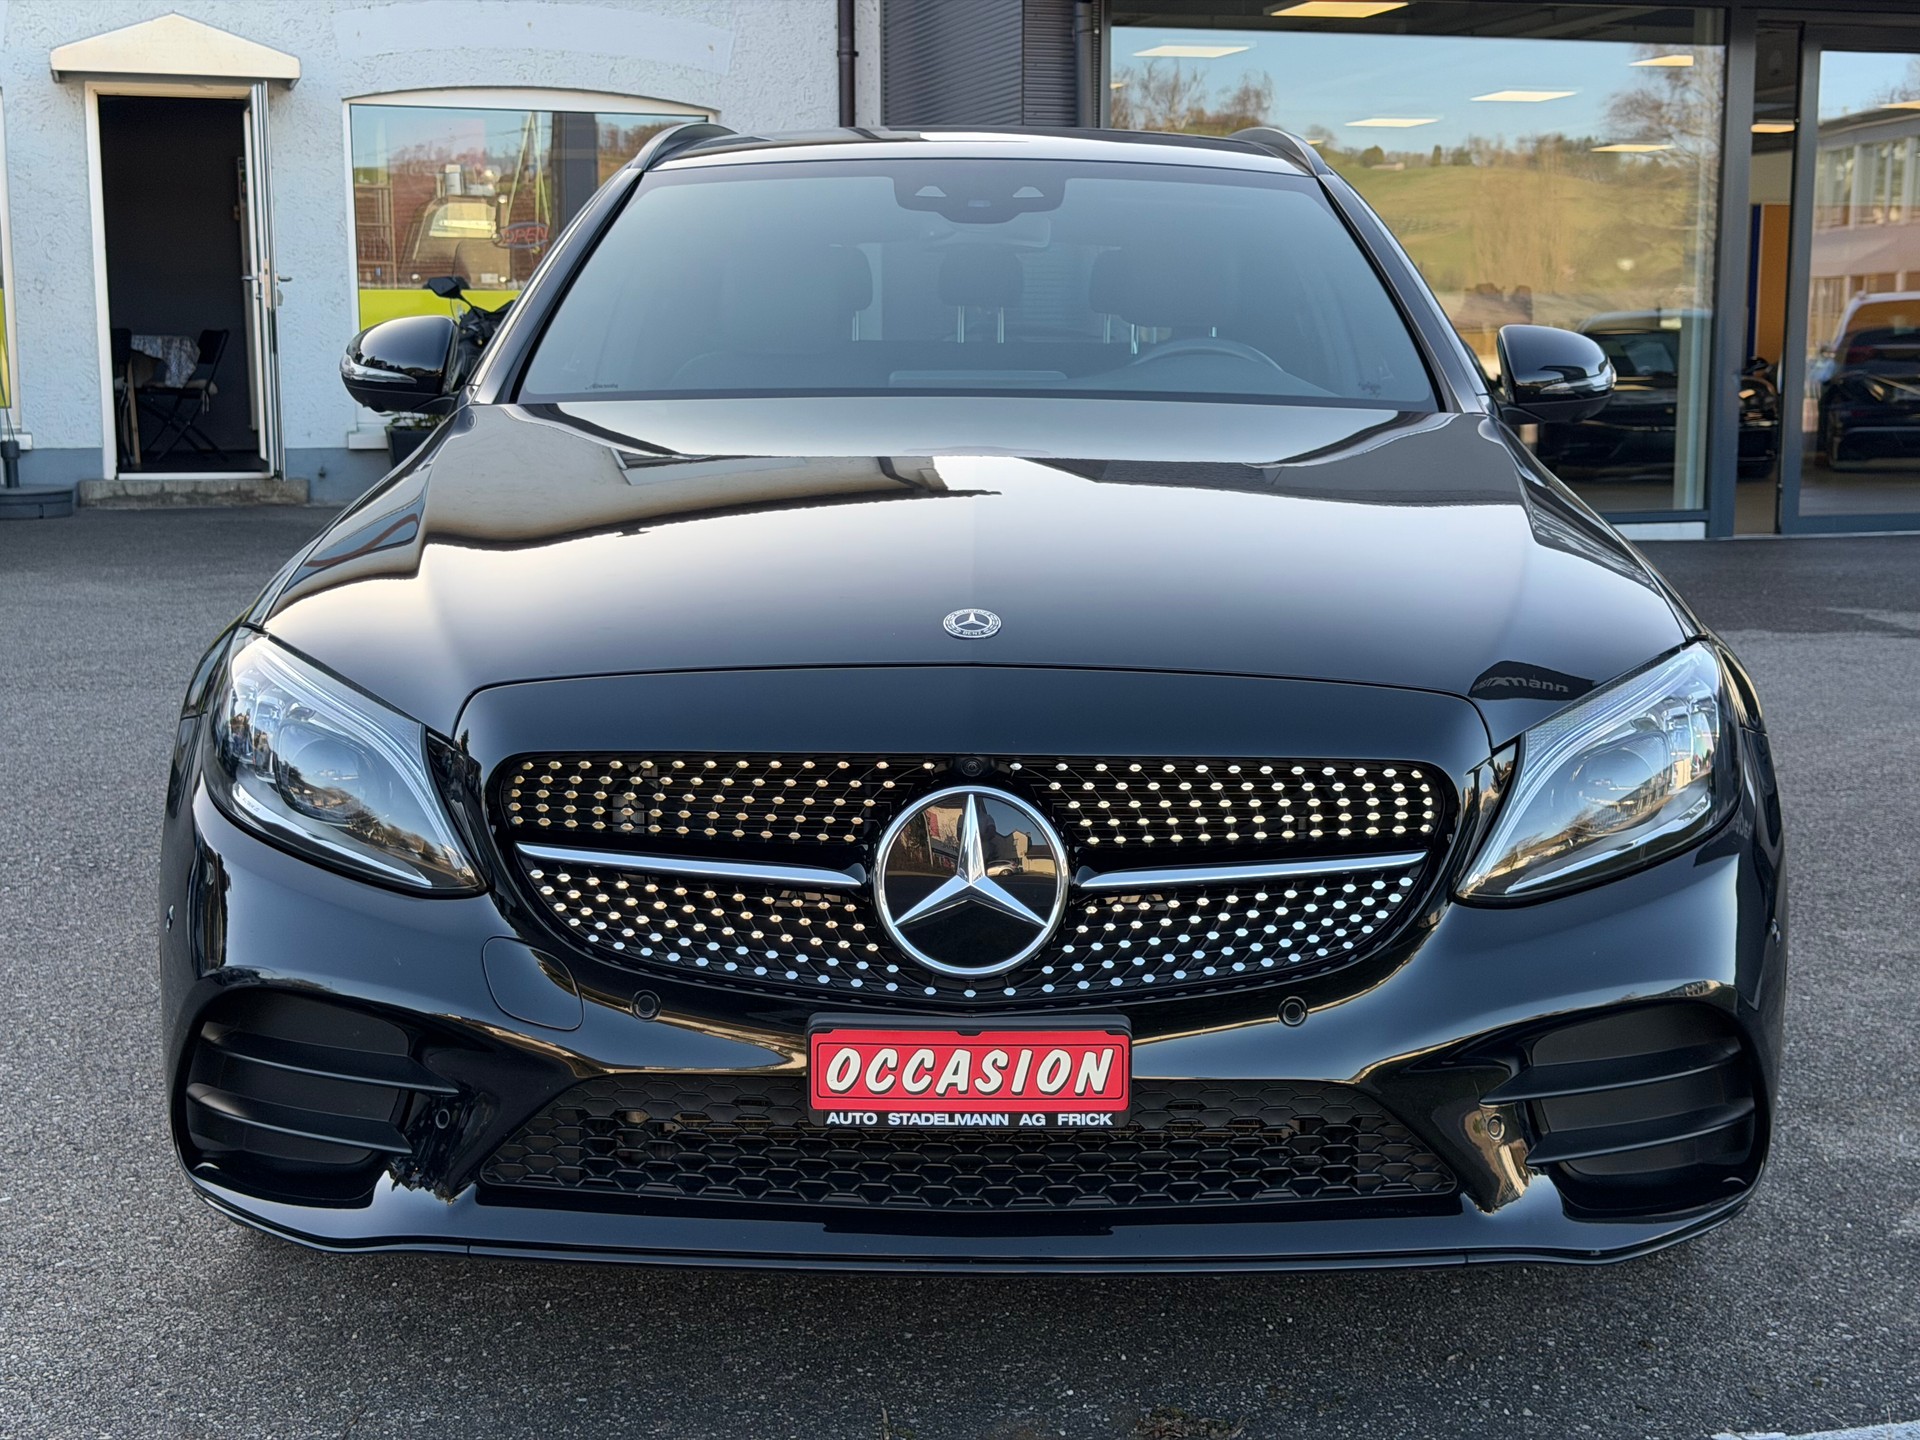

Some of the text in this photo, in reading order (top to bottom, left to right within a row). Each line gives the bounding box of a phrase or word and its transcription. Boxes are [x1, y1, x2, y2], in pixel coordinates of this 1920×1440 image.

[826, 1047, 1114, 1096] OCCASION
[826, 1112, 1113, 1127] AUTO STADELMANN AG FRICK
